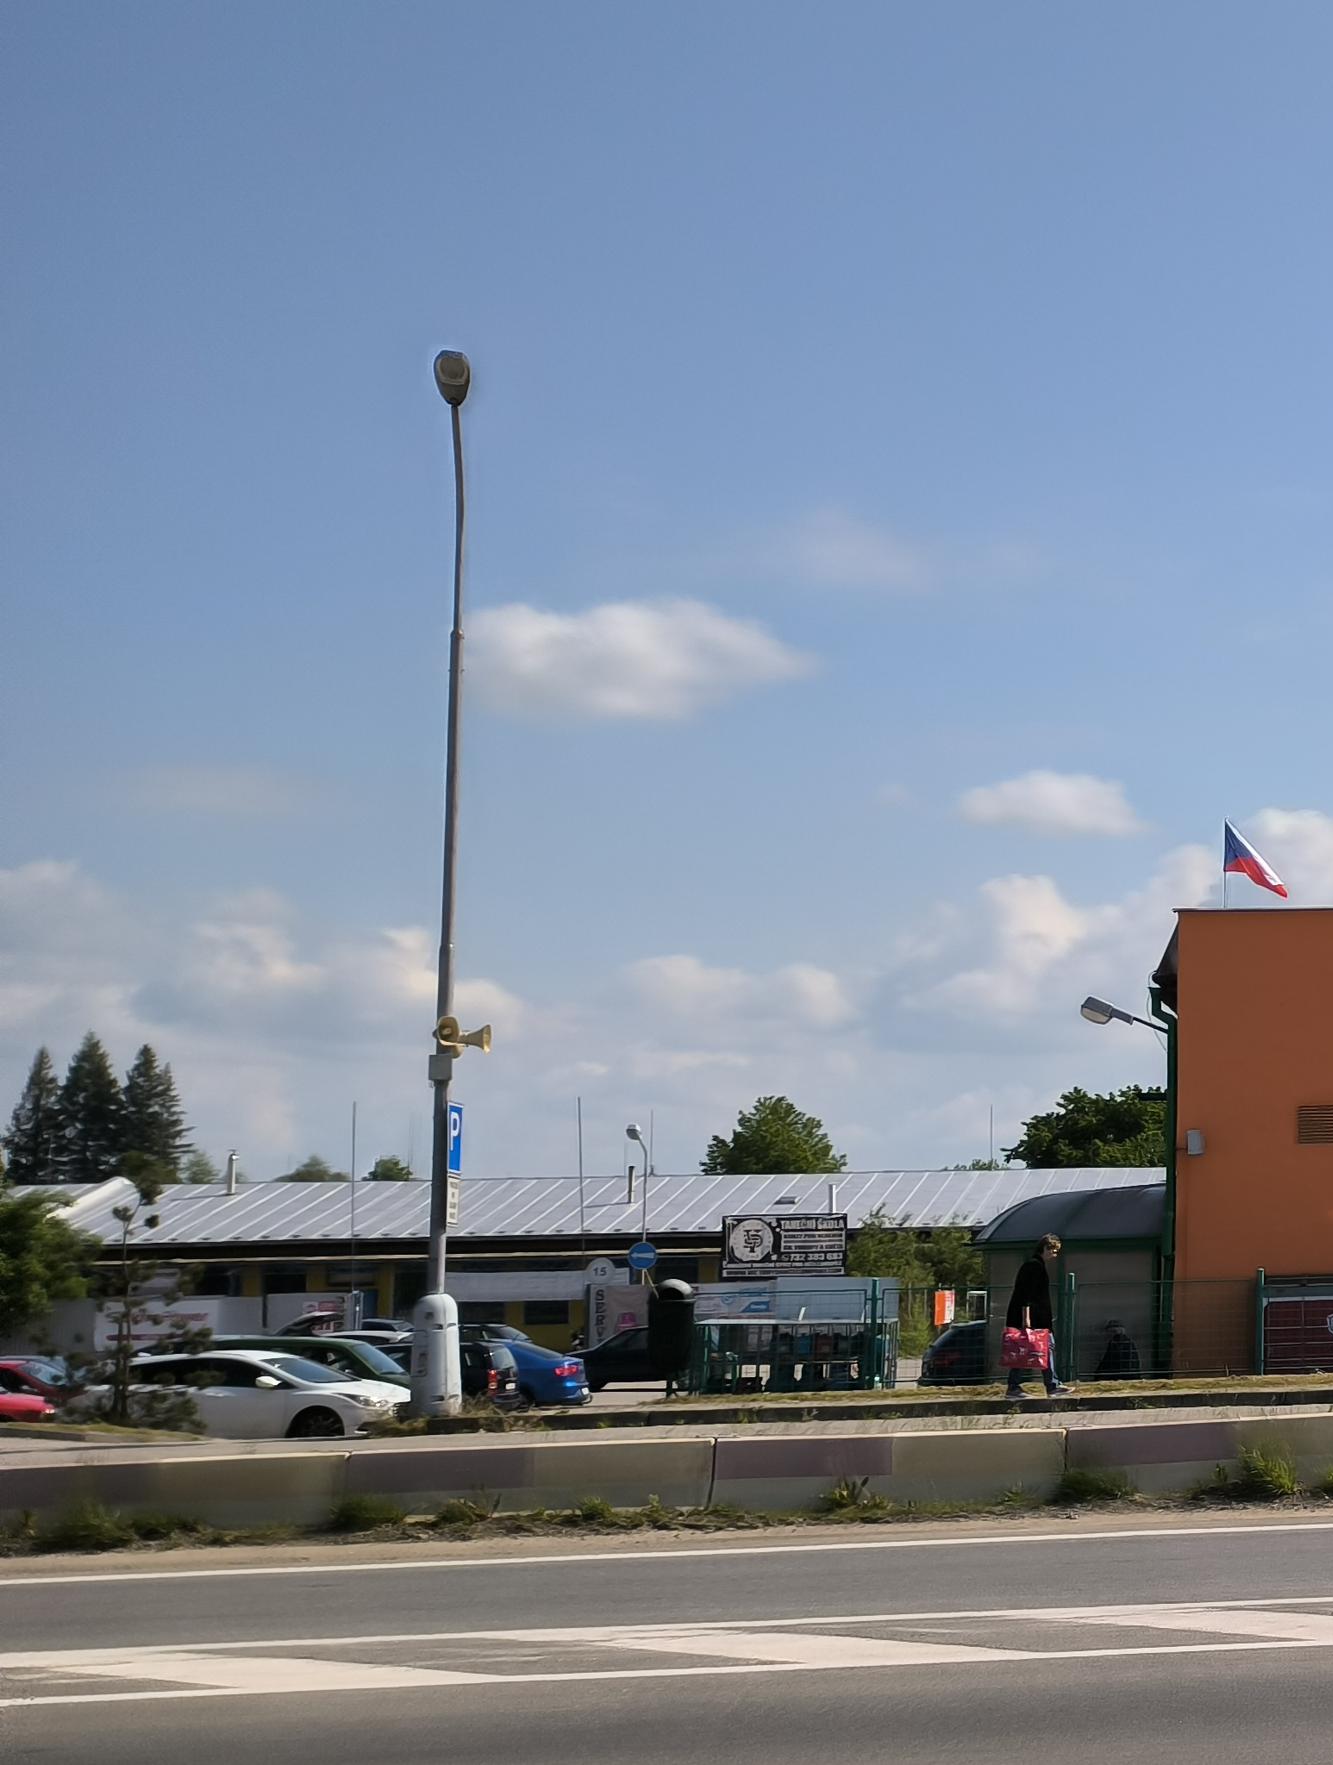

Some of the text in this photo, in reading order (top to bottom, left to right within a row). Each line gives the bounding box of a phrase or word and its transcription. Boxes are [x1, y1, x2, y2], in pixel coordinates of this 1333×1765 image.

[450, 1111, 460, 1151] P
[593, 1267, 607, 1276] 15
[595, 1289, 606, 1342] SERV
